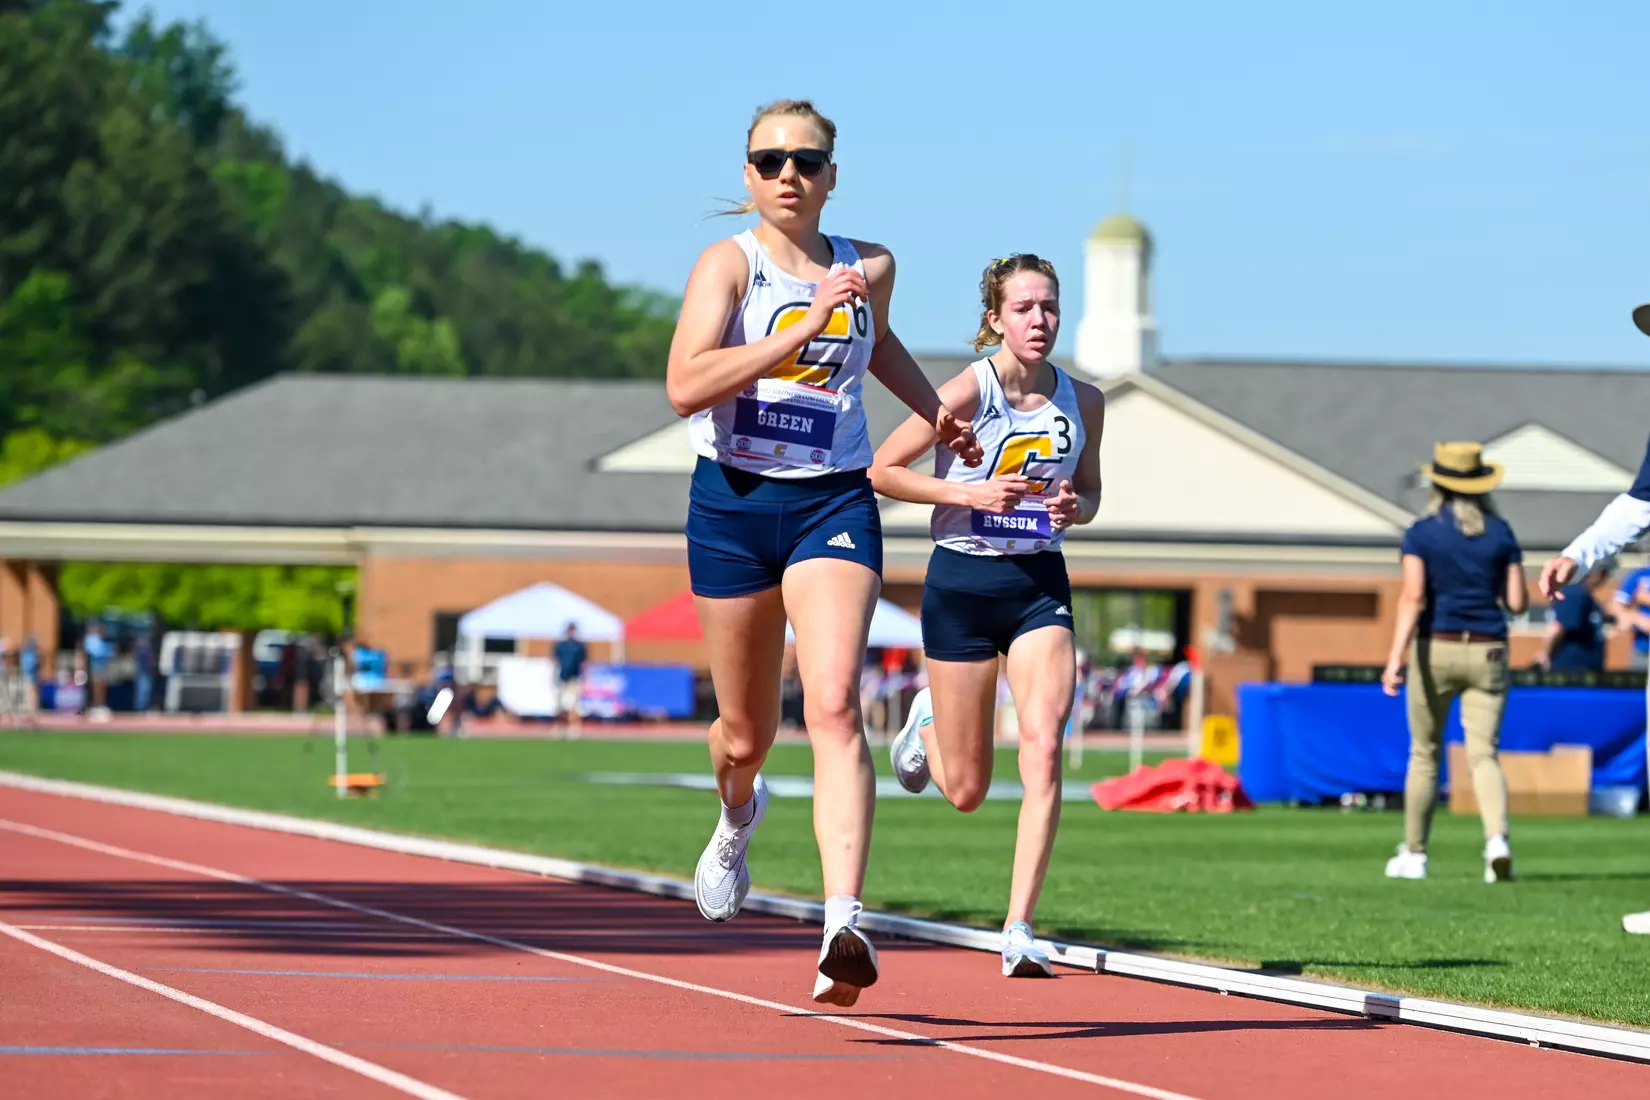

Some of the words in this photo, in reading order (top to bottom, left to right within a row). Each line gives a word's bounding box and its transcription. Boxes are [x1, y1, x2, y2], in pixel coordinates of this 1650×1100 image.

[757, 409, 814, 434] GREEN
[1053, 415, 1071, 454] 3
[983, 515, 1038, 530] RUSSUM
